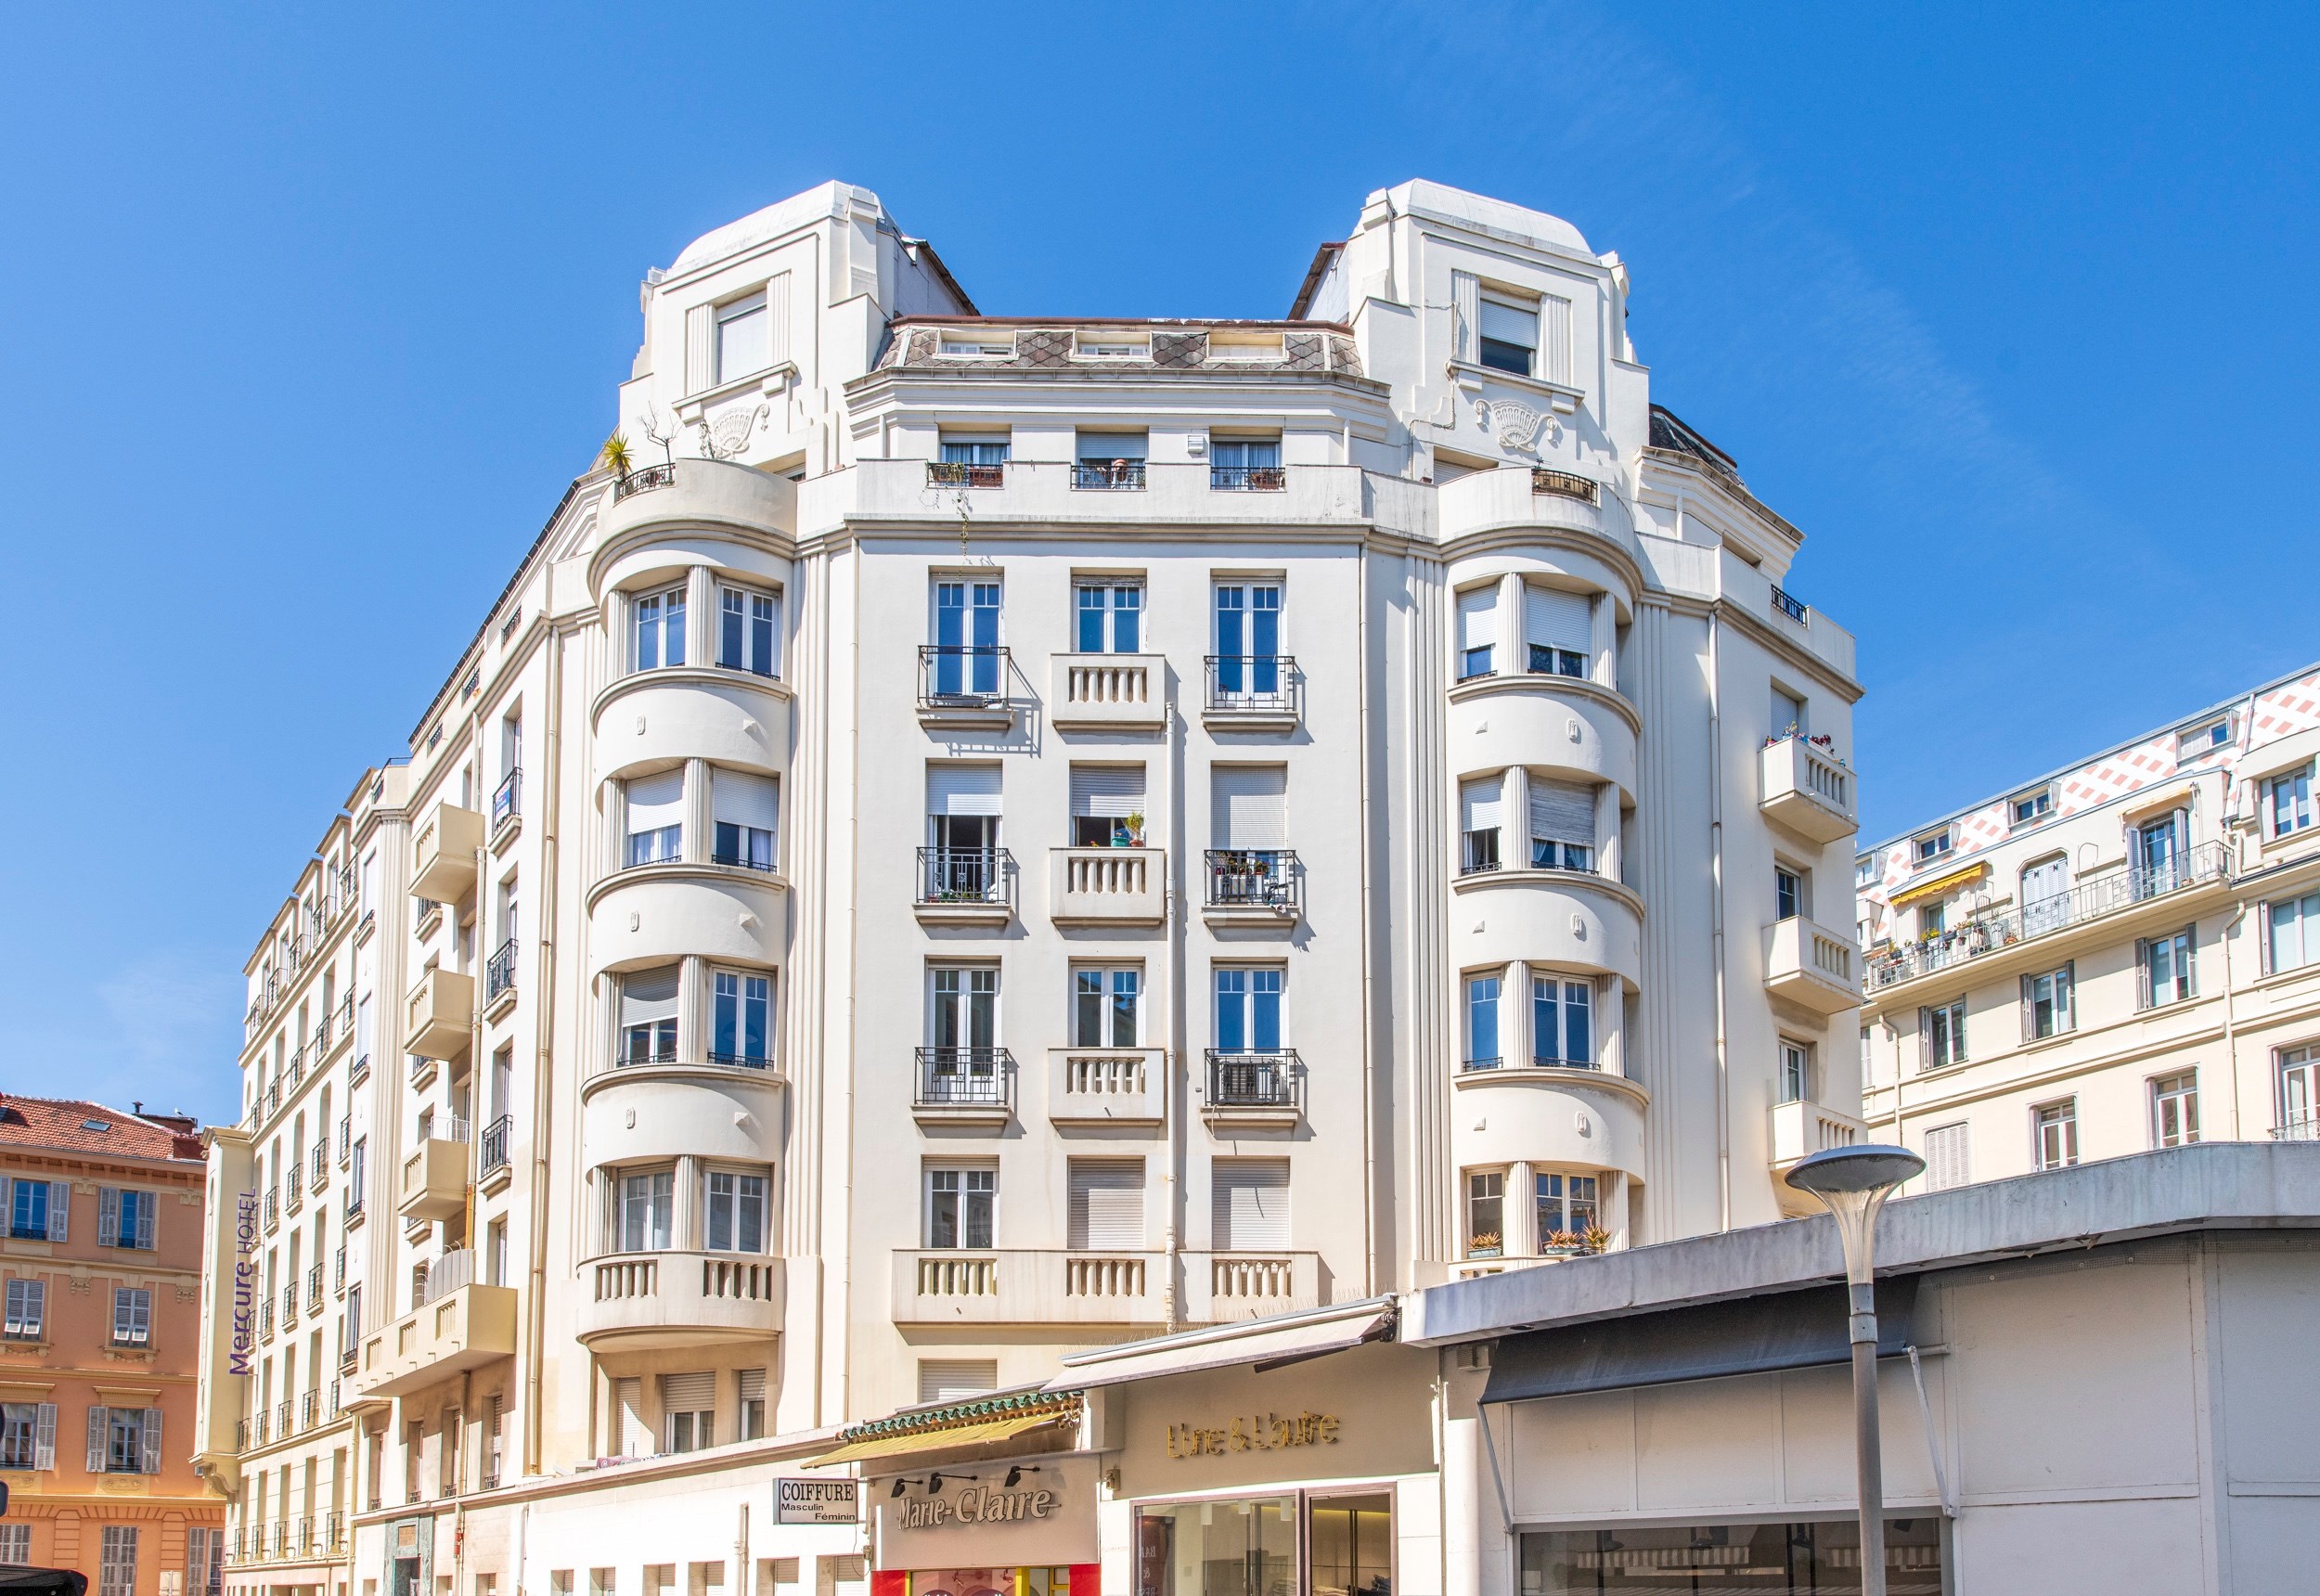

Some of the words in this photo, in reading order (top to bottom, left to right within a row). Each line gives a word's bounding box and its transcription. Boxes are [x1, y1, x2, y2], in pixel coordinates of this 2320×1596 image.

[238, 1187, 256, 1254] HOTEL
[229, 1261, 253, 1375] Mercure
[1229, 1417, 1250, 1452] &
[781, 1482, 854, 1501] COIFFURE
